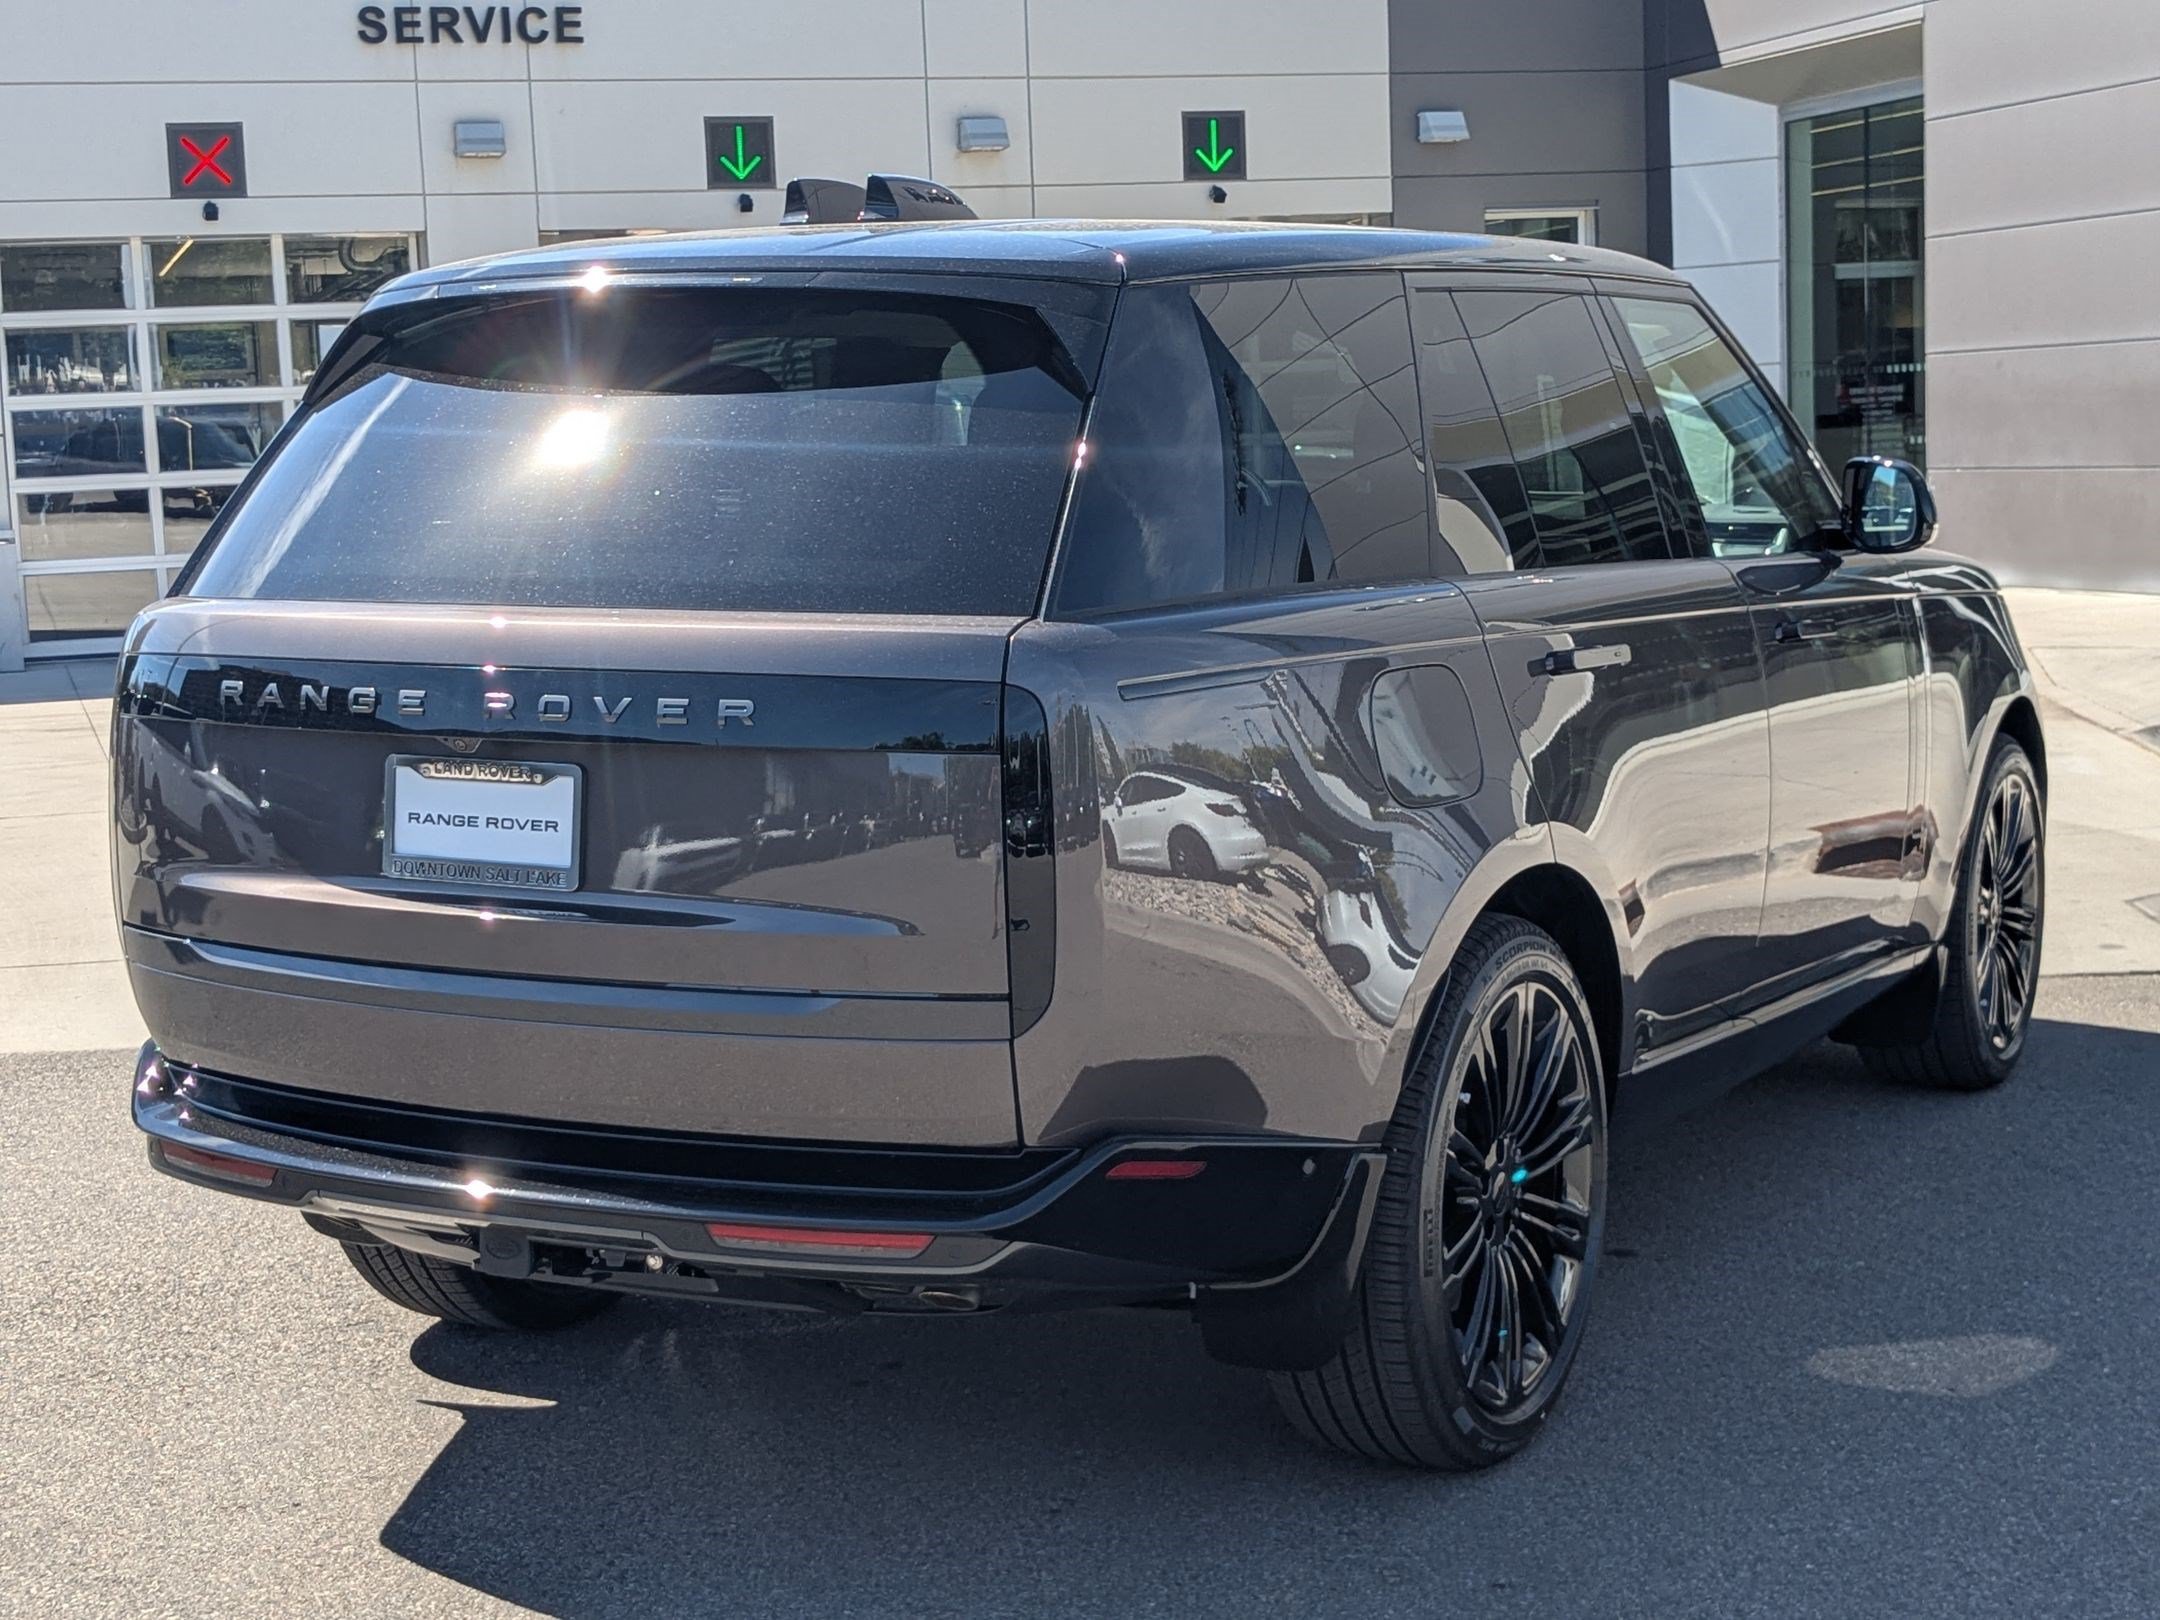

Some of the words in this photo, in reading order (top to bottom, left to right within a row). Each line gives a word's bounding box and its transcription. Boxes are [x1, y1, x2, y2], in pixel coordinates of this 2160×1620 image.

[357, 6, 585, 44] SERVICE
[219, 680, 427, 716] RANGE
[483, 692, 756, 727] ROVER
[433, 761, 474, 778] LAND
[478, 764, 533, 781] ROVER
[408, 812, 480, 828] RANGE
[485, 817, 559, 832] ROVER
[393, 859, 481, 879] DOWNTOWN
[485, 867, 521, 881] SALT
[526, 869, 568, 887] LAKE
[1495, 940, 1547, 970] SCORPION
